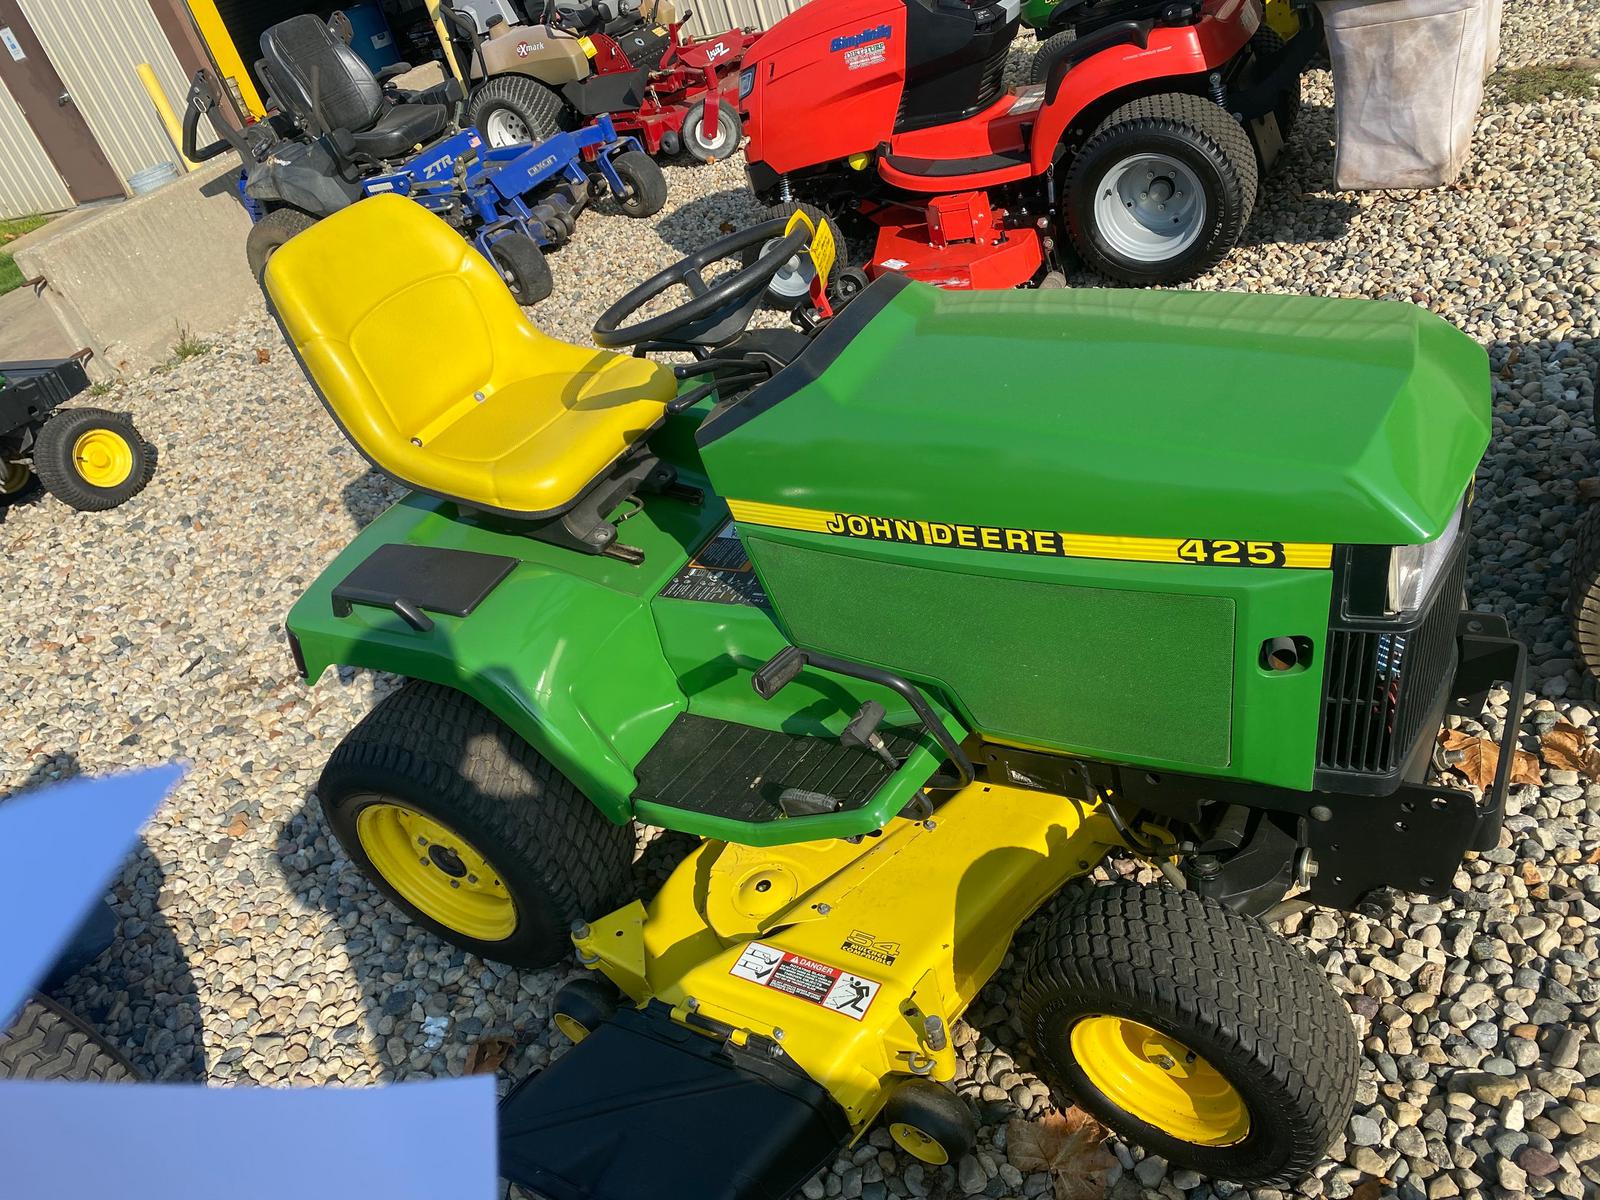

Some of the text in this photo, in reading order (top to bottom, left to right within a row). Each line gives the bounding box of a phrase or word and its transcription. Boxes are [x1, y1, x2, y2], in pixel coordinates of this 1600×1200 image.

[423, 154, 454, 179] ZTR
[826, 513, 1066, 556] JOHN DEERE
[1177, 538, 1286, 568] 425
[846, 929, 901, 956] 54
[850, 944, 888, 960] MULCHER
[799, 958, 834, 976] DANGER
[842, 945, 893, 966] COMPATIBLE
